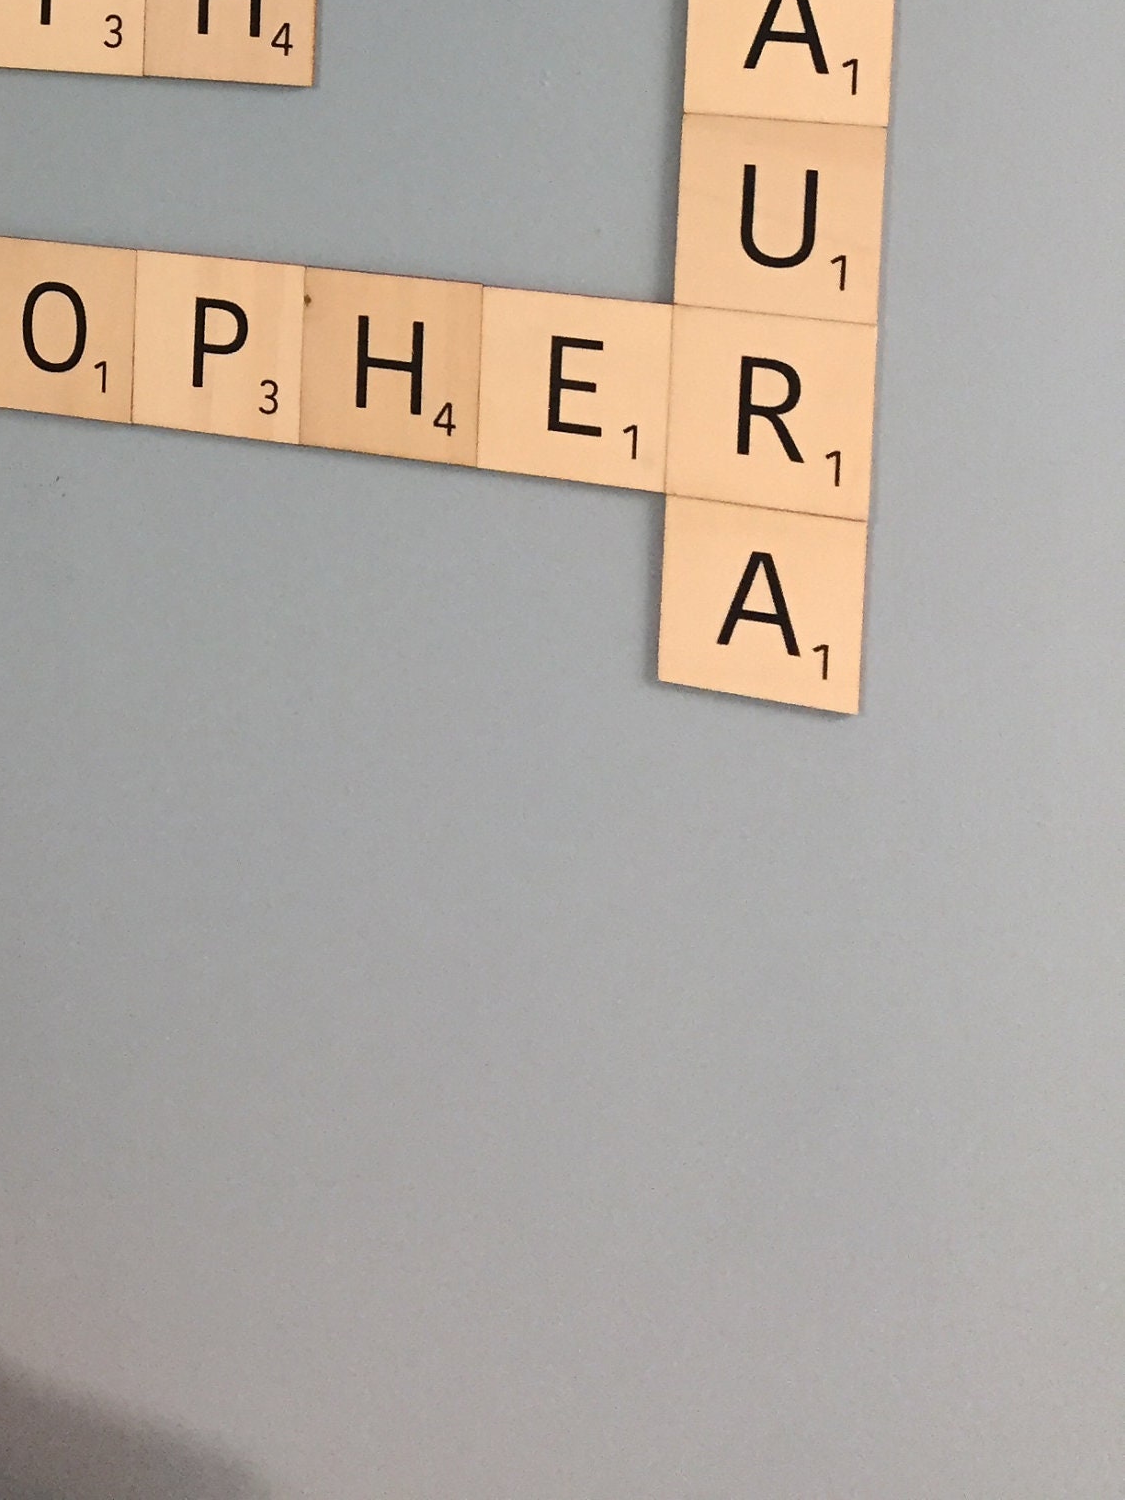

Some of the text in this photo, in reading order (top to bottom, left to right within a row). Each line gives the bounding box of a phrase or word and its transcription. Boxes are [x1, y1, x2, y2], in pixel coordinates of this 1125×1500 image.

[102, 13, 124, 50] 3
[269, 21, 295, 58] 4
[841, 57, 860, 97] 1
[829, 253, 848, 293] 1
[92, 359, 108, 395] 1
[257, 378, 280, 416] 3
[431, 401, 458, 438] 4
[621, 423, 639, 461] 1
[824, 449, 842, 488] 1
[811, 643, 831, 681] 1
